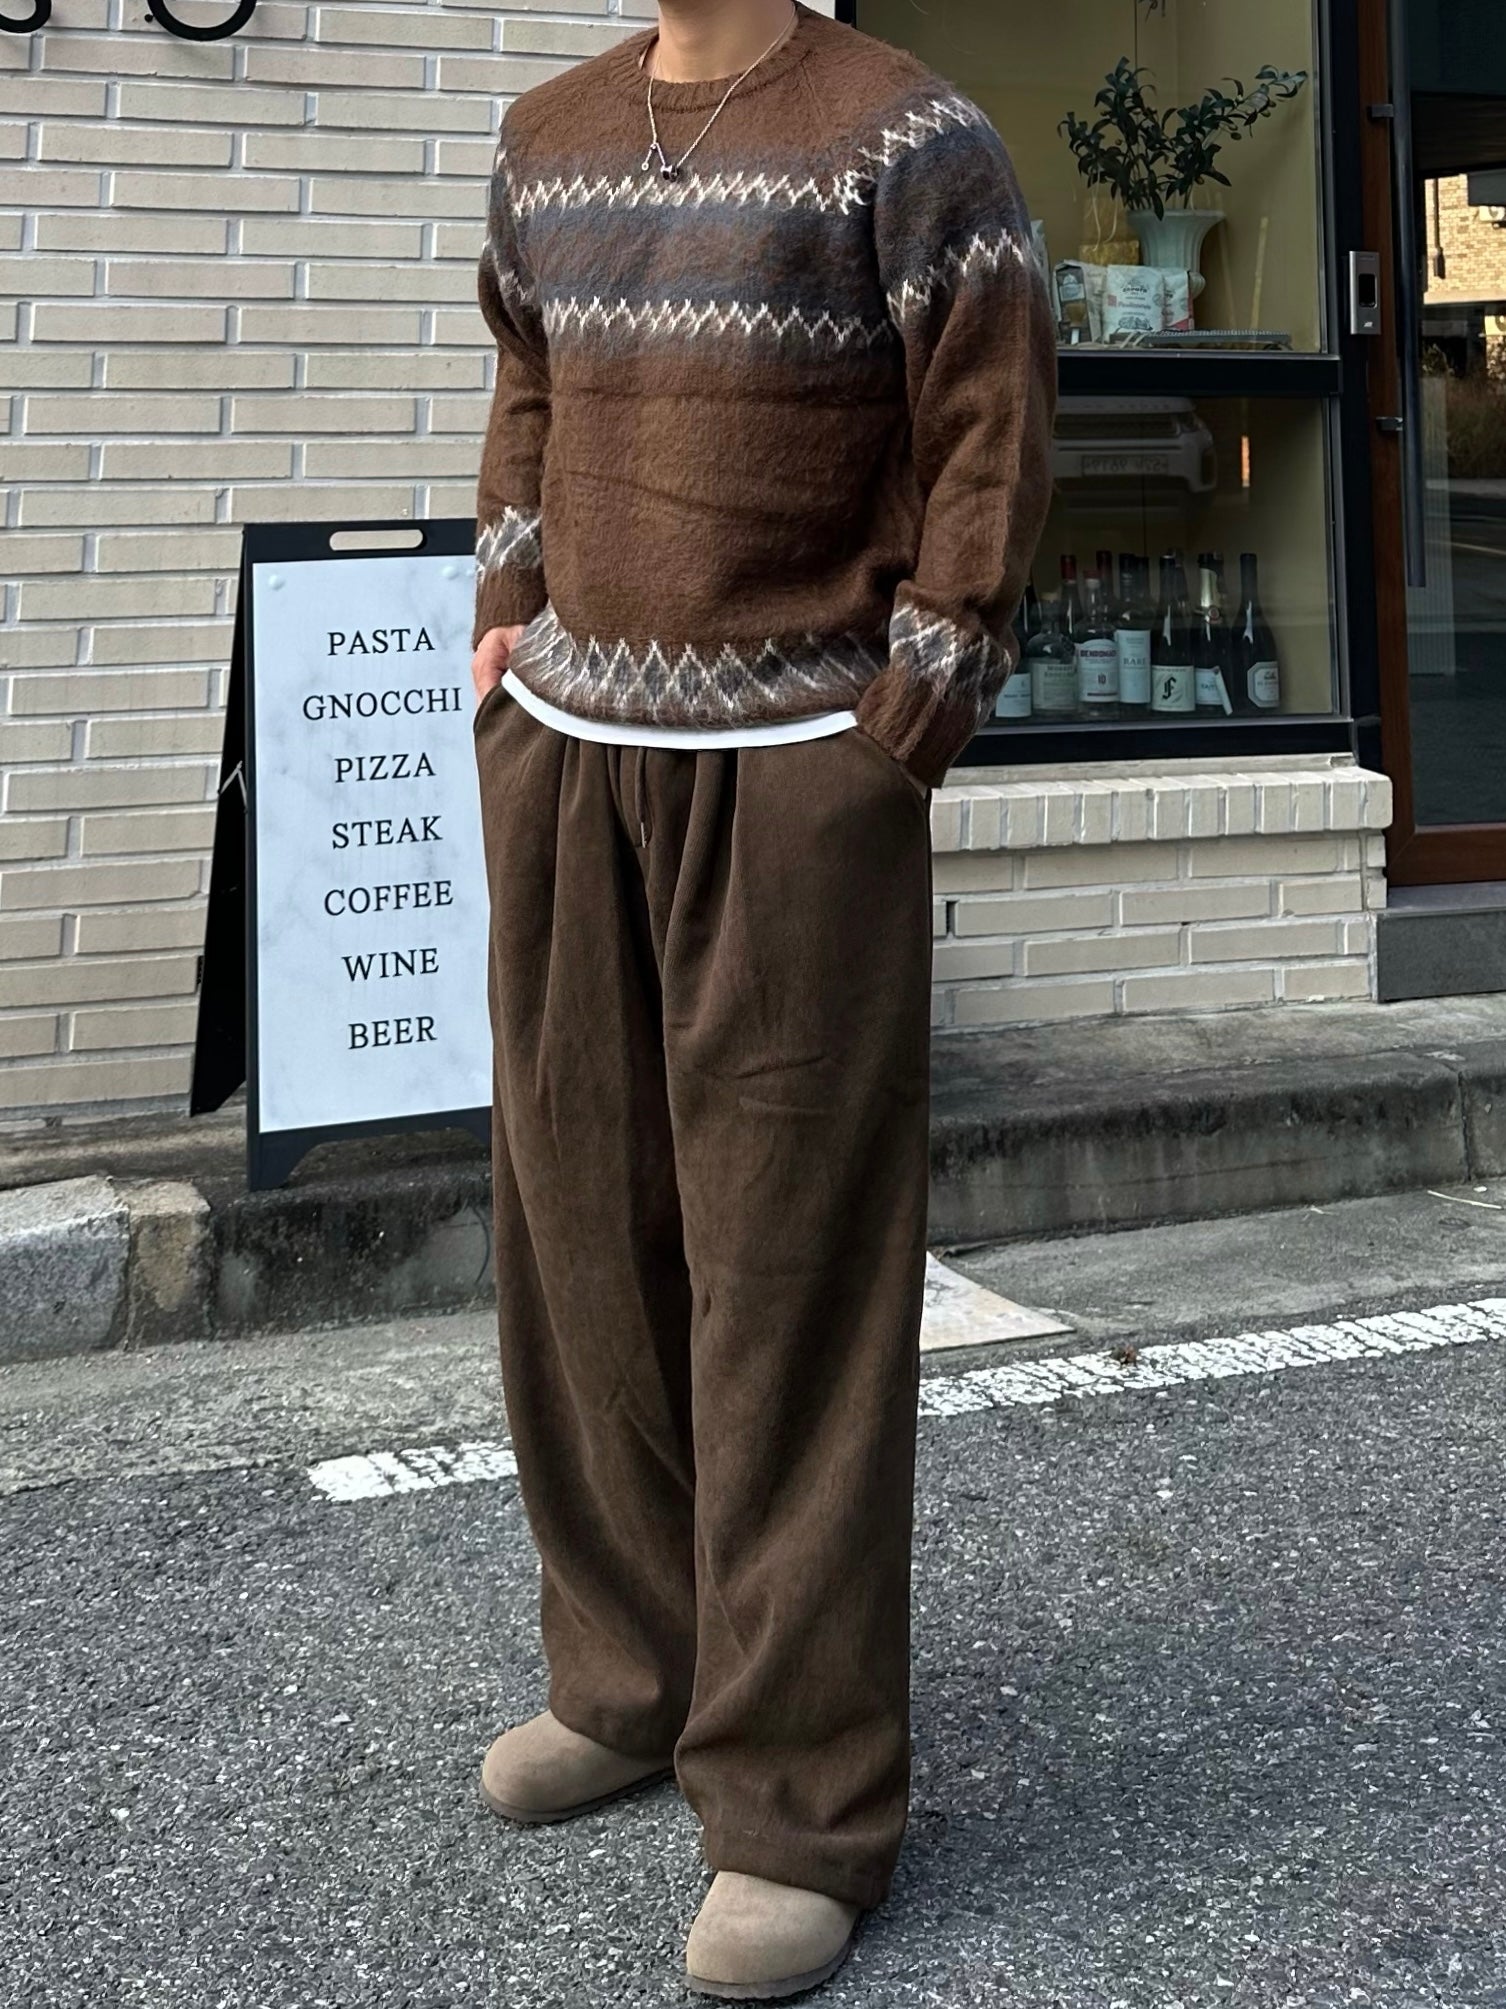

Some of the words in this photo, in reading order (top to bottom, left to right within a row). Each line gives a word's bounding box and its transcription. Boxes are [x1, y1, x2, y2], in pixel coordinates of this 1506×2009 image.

[328, 628, 435, 656] PASTA
[302, 688, 462, 721] GNOCCHI
[334, 752, 436, 783] PIZZA
[332, 815, 443, 850] STEAK
[324, 880, 454, 916] COFFEE
[341, 947, 439, 982] WINE
[348, 1015, 437, 1050] BEER
